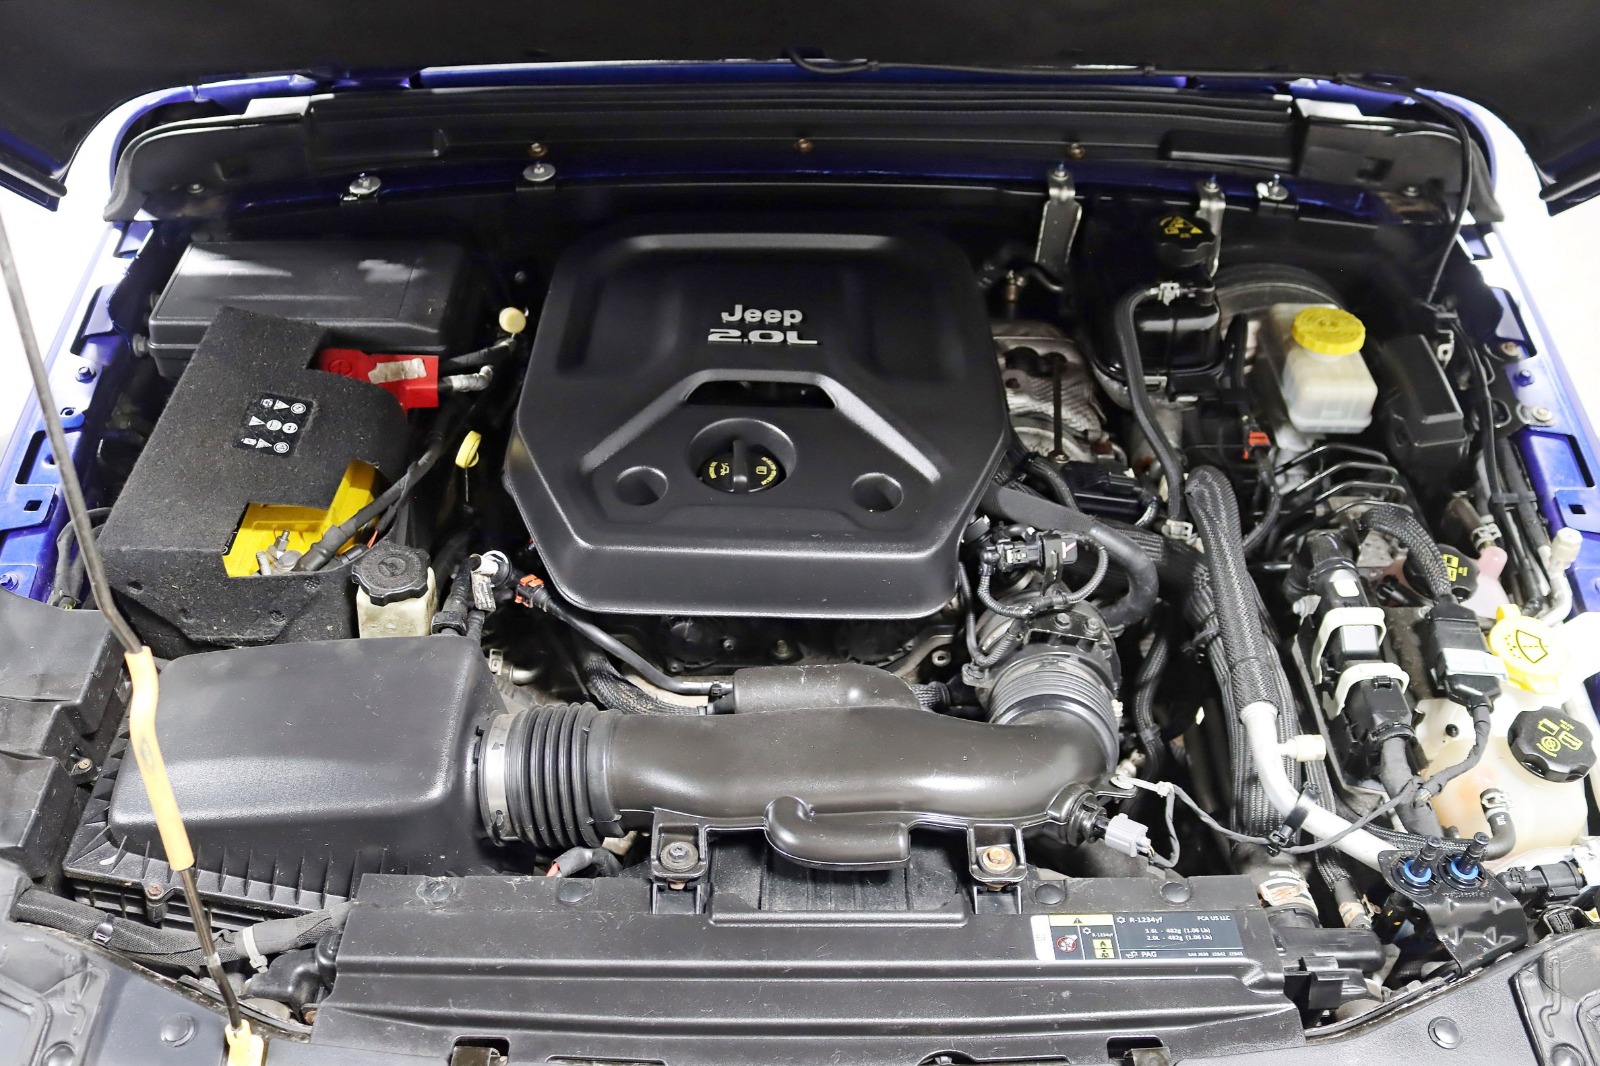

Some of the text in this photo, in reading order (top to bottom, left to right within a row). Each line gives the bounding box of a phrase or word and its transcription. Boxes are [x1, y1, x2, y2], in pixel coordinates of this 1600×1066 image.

[721, 304, 803, 326] Jeep
[707, 328, 818, 344] 2.0L
[1129, 916, 1163, 924] R-1234yf
